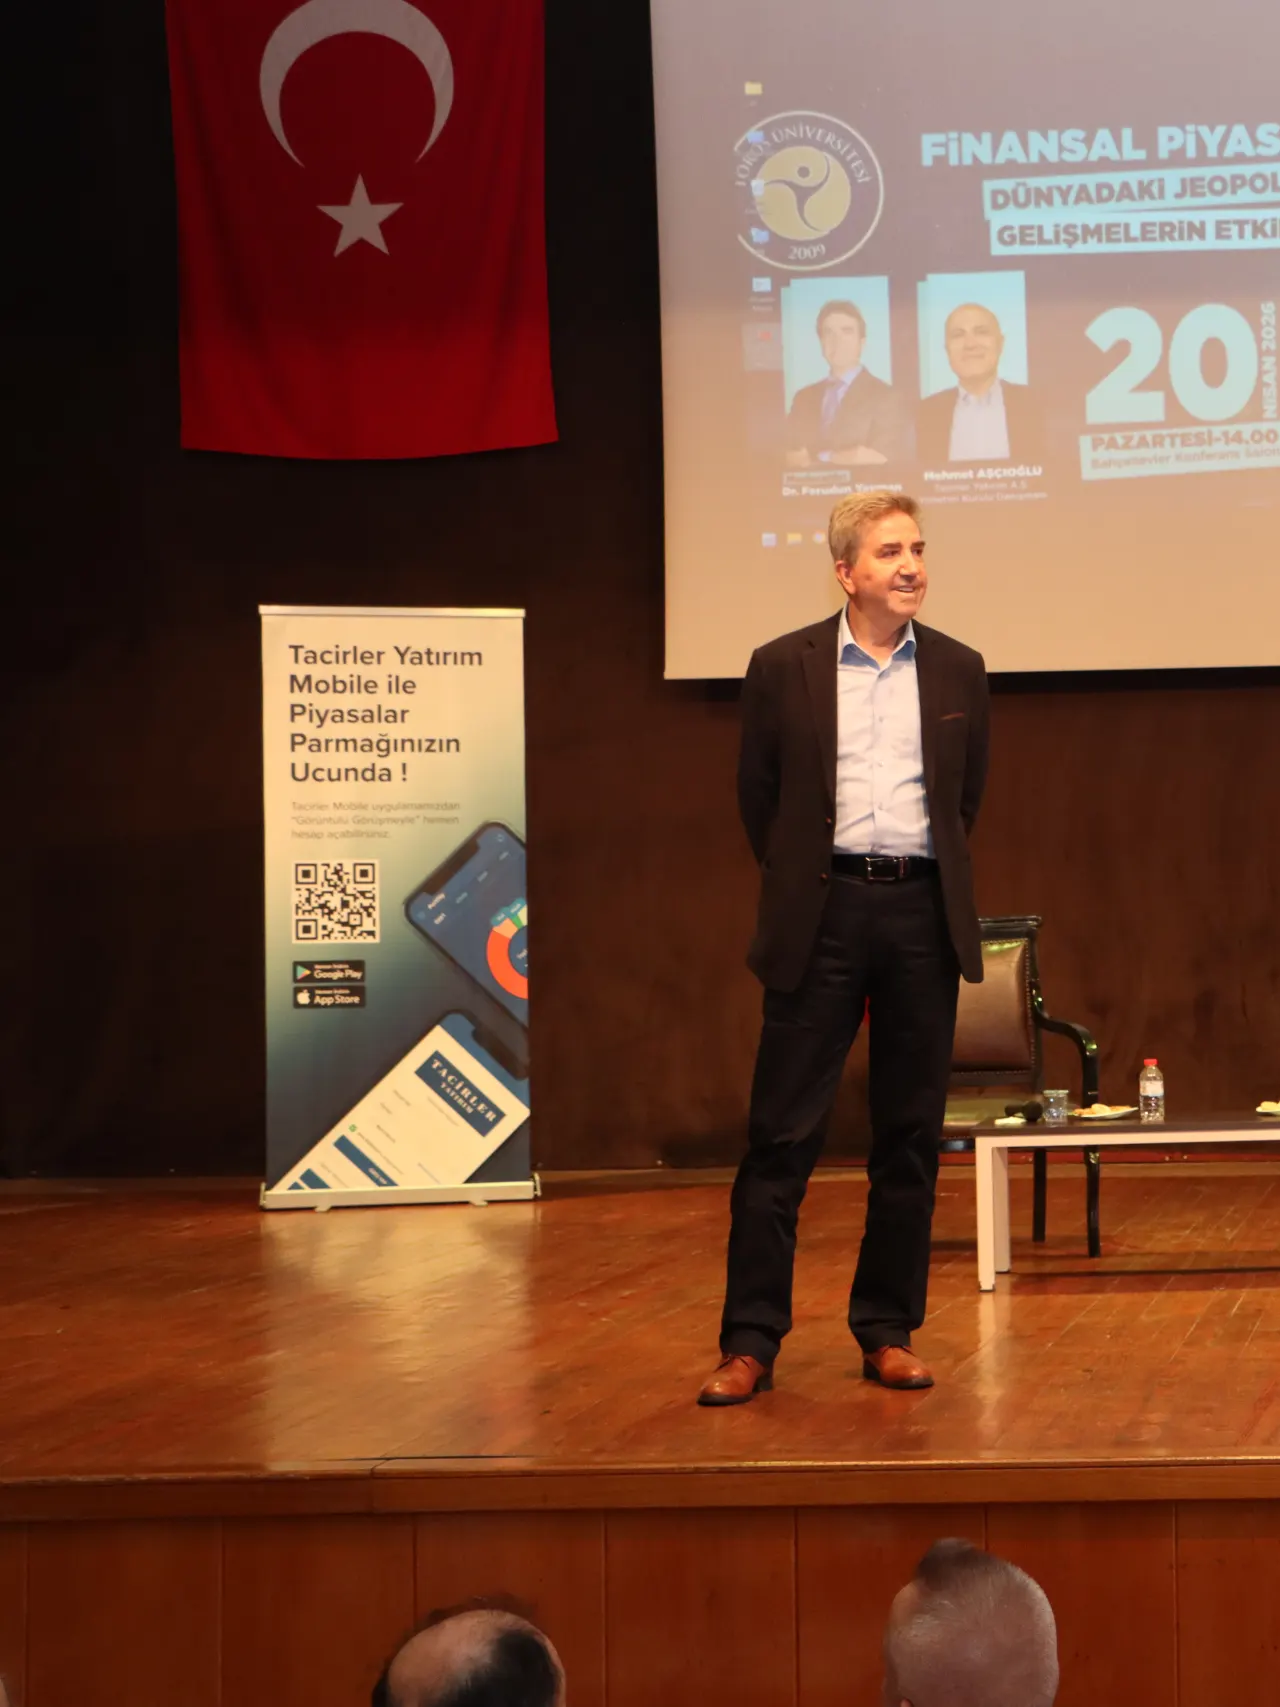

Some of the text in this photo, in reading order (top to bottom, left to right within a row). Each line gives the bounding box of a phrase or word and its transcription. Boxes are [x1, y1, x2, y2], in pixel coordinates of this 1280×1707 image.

[788, 243, 826, 260] 2009
[1260, 300, 1276, 352] 2026
[1084, 303, 1259, 425] 20
[288, 645, 483, 666] Tacirler Yatırım
[289, 674, 417, 695] Mobile ile
[289, 703, 410, 728] Piyasalar
[290, 732, 461, 758] Parmağınızın
[290, 762, 392, 782] Ucunda
[333, 801, 369, 811] Mobile
[314, 969, 363, 981] Google Play
[314, 995, 360, 1006] App Store
